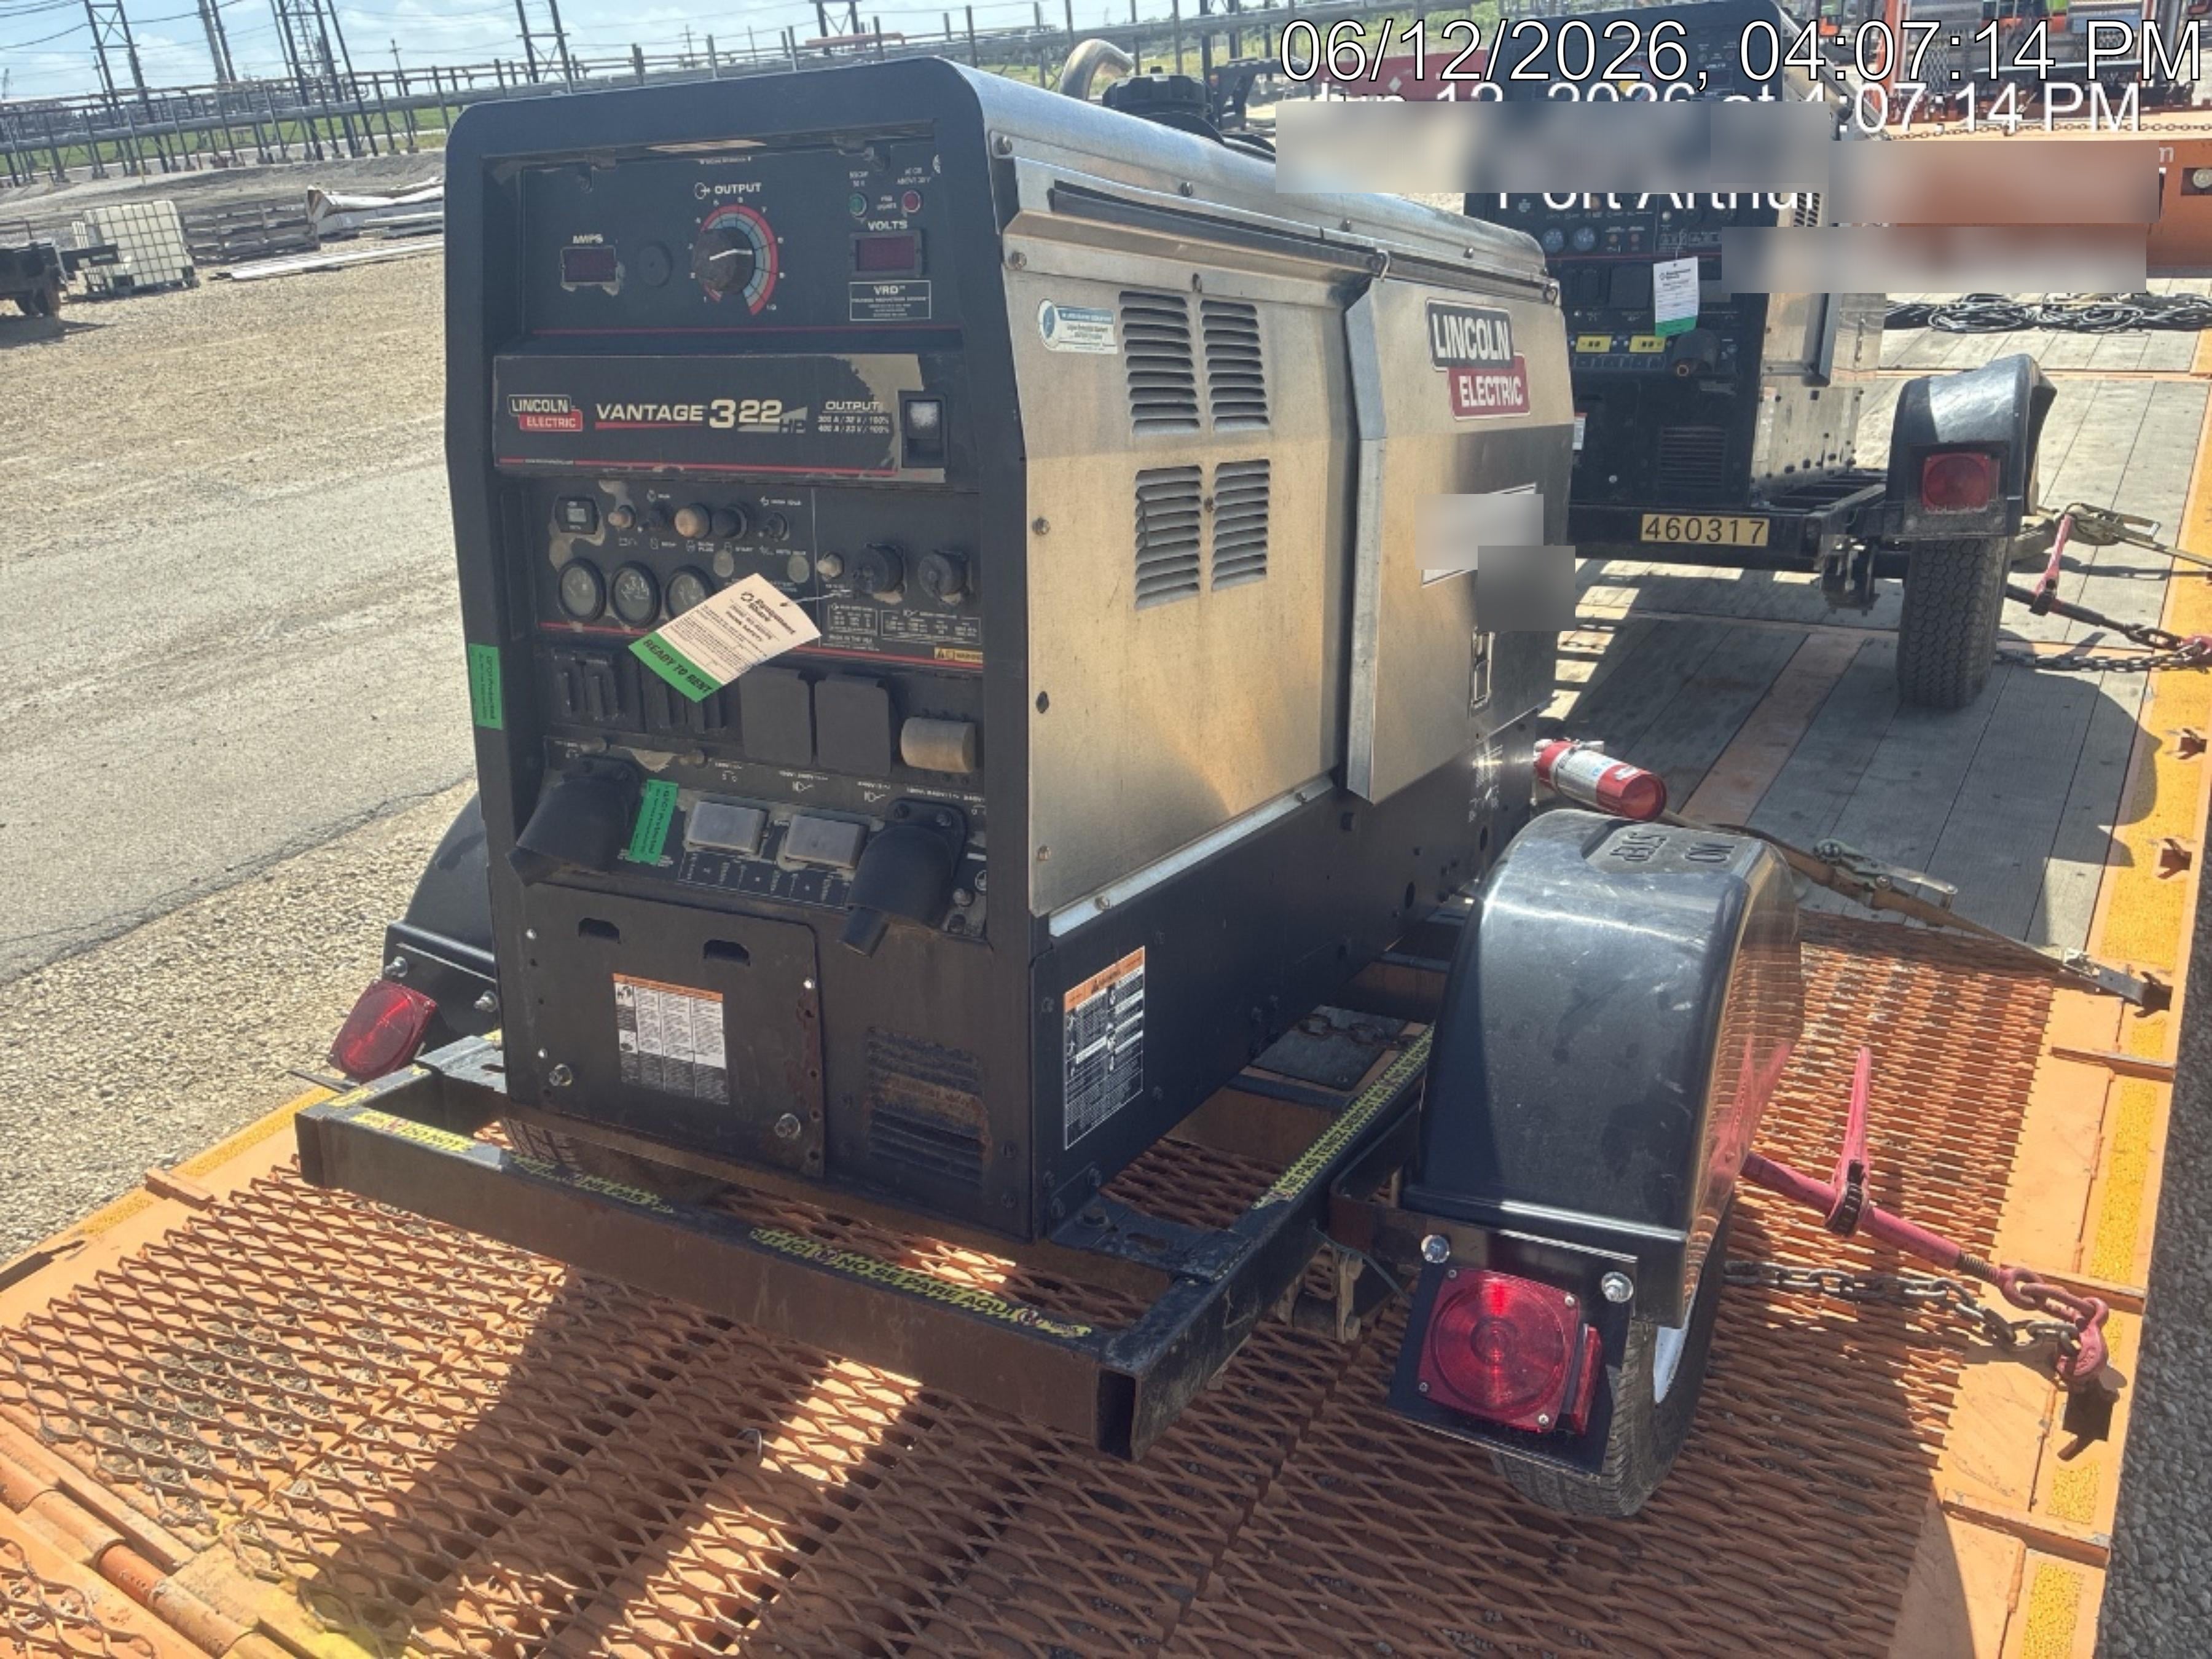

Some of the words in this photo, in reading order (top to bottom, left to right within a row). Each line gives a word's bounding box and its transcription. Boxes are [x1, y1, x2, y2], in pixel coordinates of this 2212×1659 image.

[714, 182, 762, 194] OUTPUT
[868, 220, 908, 230] VOLTS
[573, 233, 603, 244] AMPS
[1432, 312, 1511, 361] LINCOLN
[1459, 373, 1523, 409] ELECTRIC
[512, 399, 569, 413] LINCOLN
[596, 403, 704, 422] VANTAGE
[708, 399, 783, 428] 322
[825, 401, 880, 410] OUTPUT
[527, 417, 576, 428] ELECTRIC
[1645, 517, 1765, 544] 460317
[643, 638, 675, 667] READY
[673, 664, 688, 677] TO
[685, 670, 713, 693] RENT
[837, 1257, 871, 1271] NO
[872, 1267, 898, 1280] SE
[903, 1277, 960, 1298] PARE
[962, 1295, 1014, 1316] AQUI
